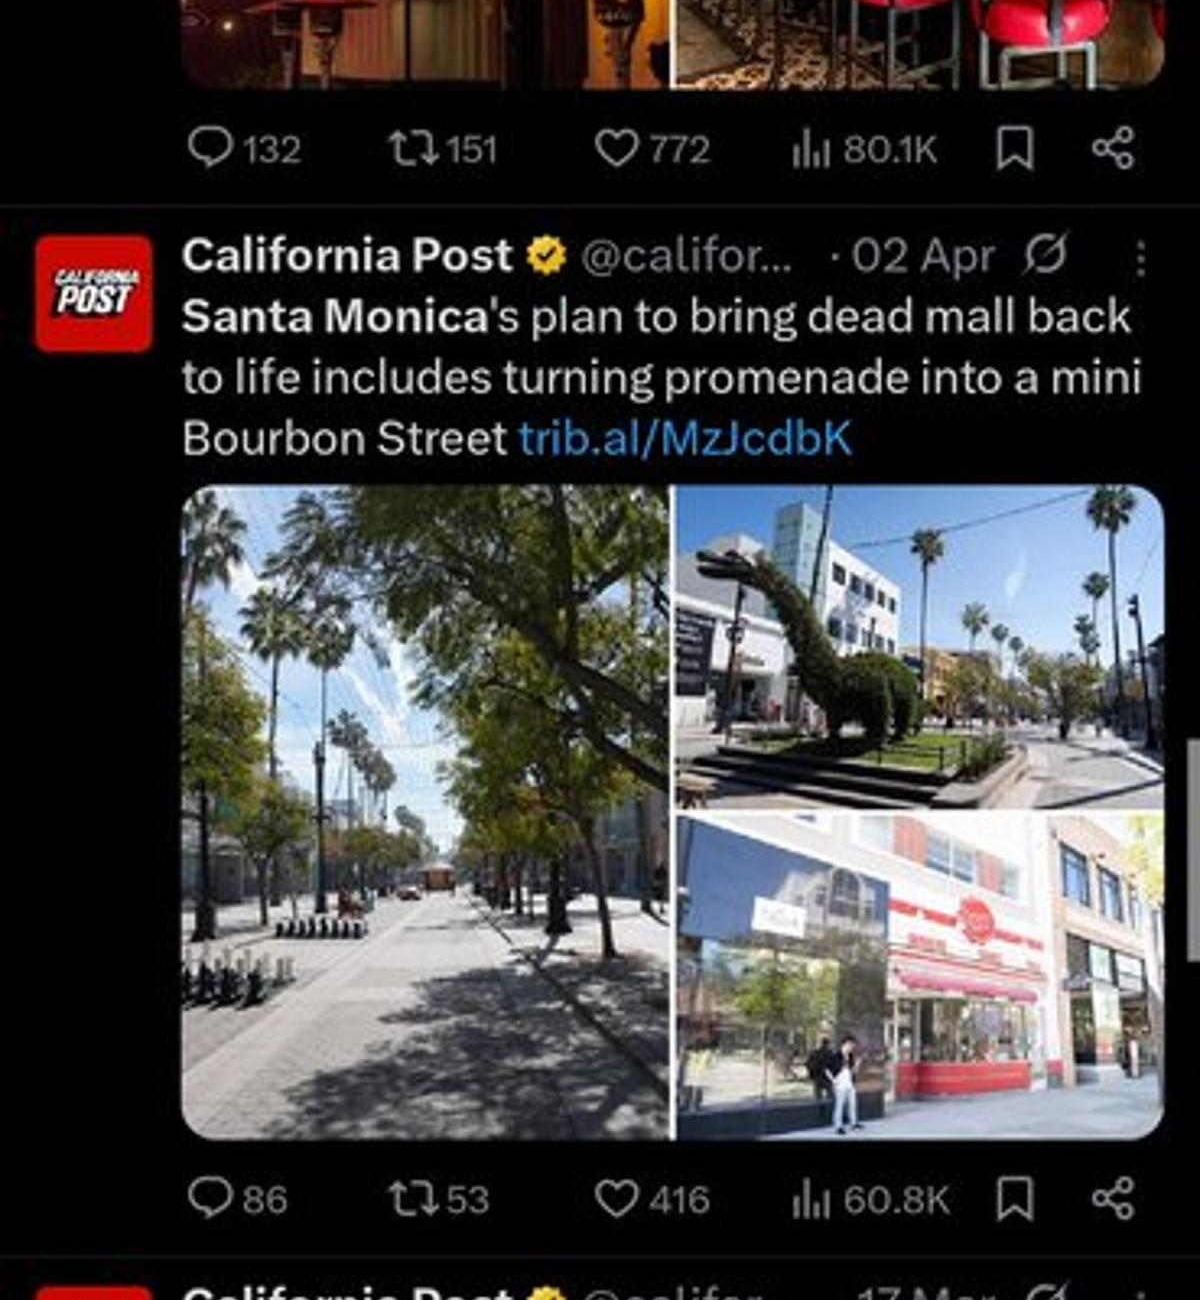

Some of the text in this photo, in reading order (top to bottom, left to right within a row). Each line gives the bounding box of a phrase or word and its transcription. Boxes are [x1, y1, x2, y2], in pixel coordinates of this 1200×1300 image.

[243, 134, 301, 164] 132
[447, 134, 496, 164] 151
[650, 134, 710, 164] 772
[844, 134, 938, 164] 80.1K
[182, 234, 514, 273] California Post
[852, 236, 996, 281] 02 Apr
[57, 285, 134, 314] POST
[182, 295, 1132, 342] Santa Monica's plan to bring dead mall back
[181, 356, 1141, 404] to life includes turning promenade into a mini
[184, 417, 852, 460] Bourbon Street trib.al/MzJcdbK
[243, 1185, 288, 1215] 86
[447, 1185, 489, 1214] 53
[649, 1185, 710, 1214] 416
[844, 1185, 950, 1215] 60.8K
